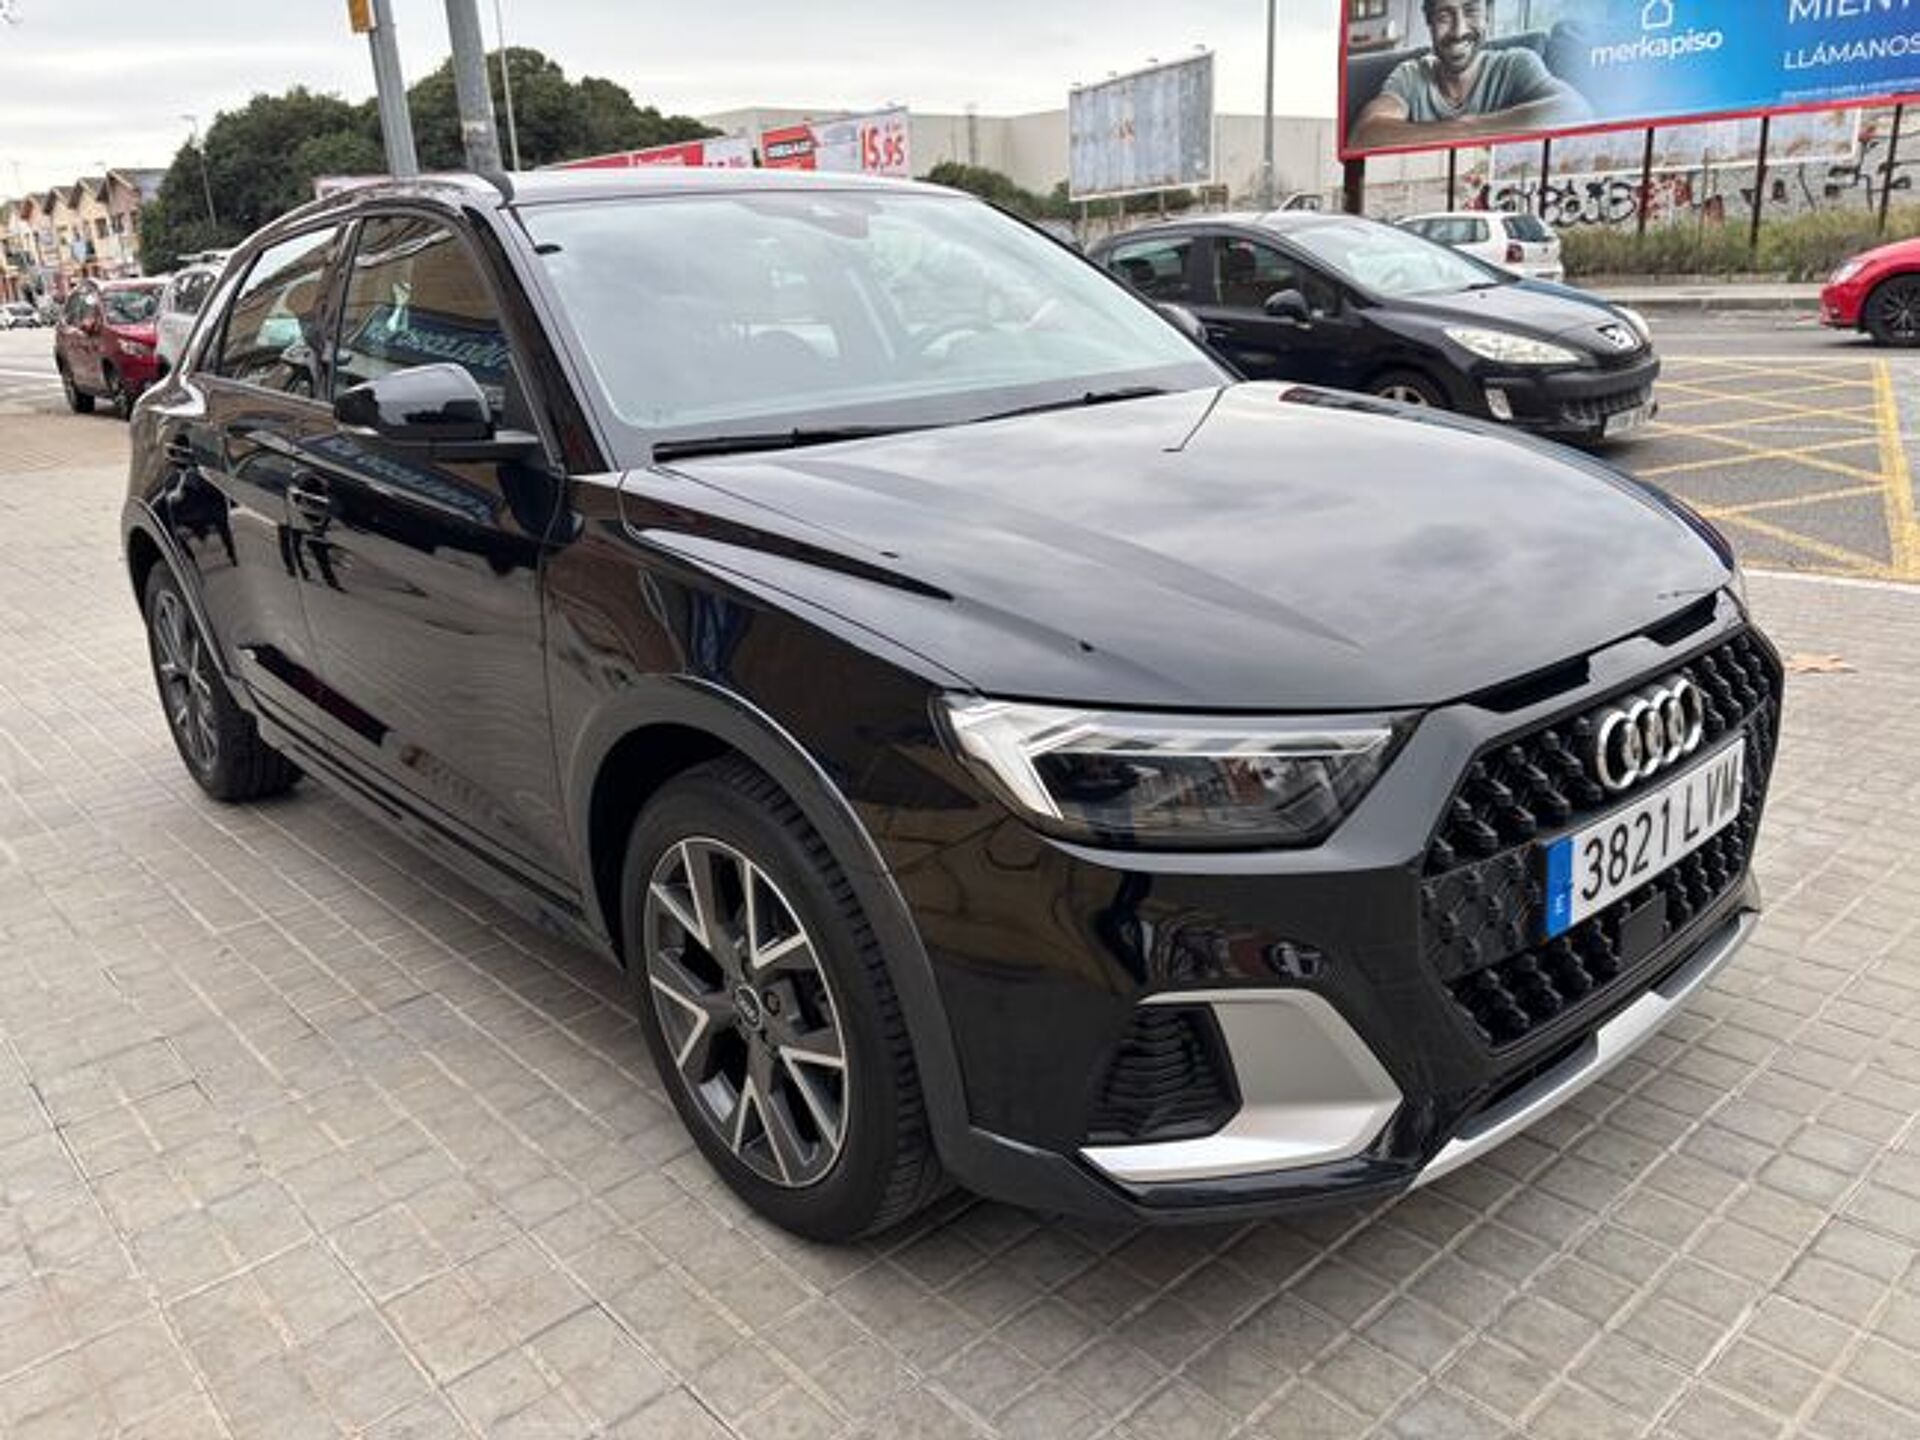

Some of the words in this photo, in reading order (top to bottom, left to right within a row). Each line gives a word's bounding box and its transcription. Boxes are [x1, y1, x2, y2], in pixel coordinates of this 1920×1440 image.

[1591, 28, 1724, 66] merkapiso
[1582, 798, 1672, 901] 3821
[1683, 754, 1740, 842] LVW
